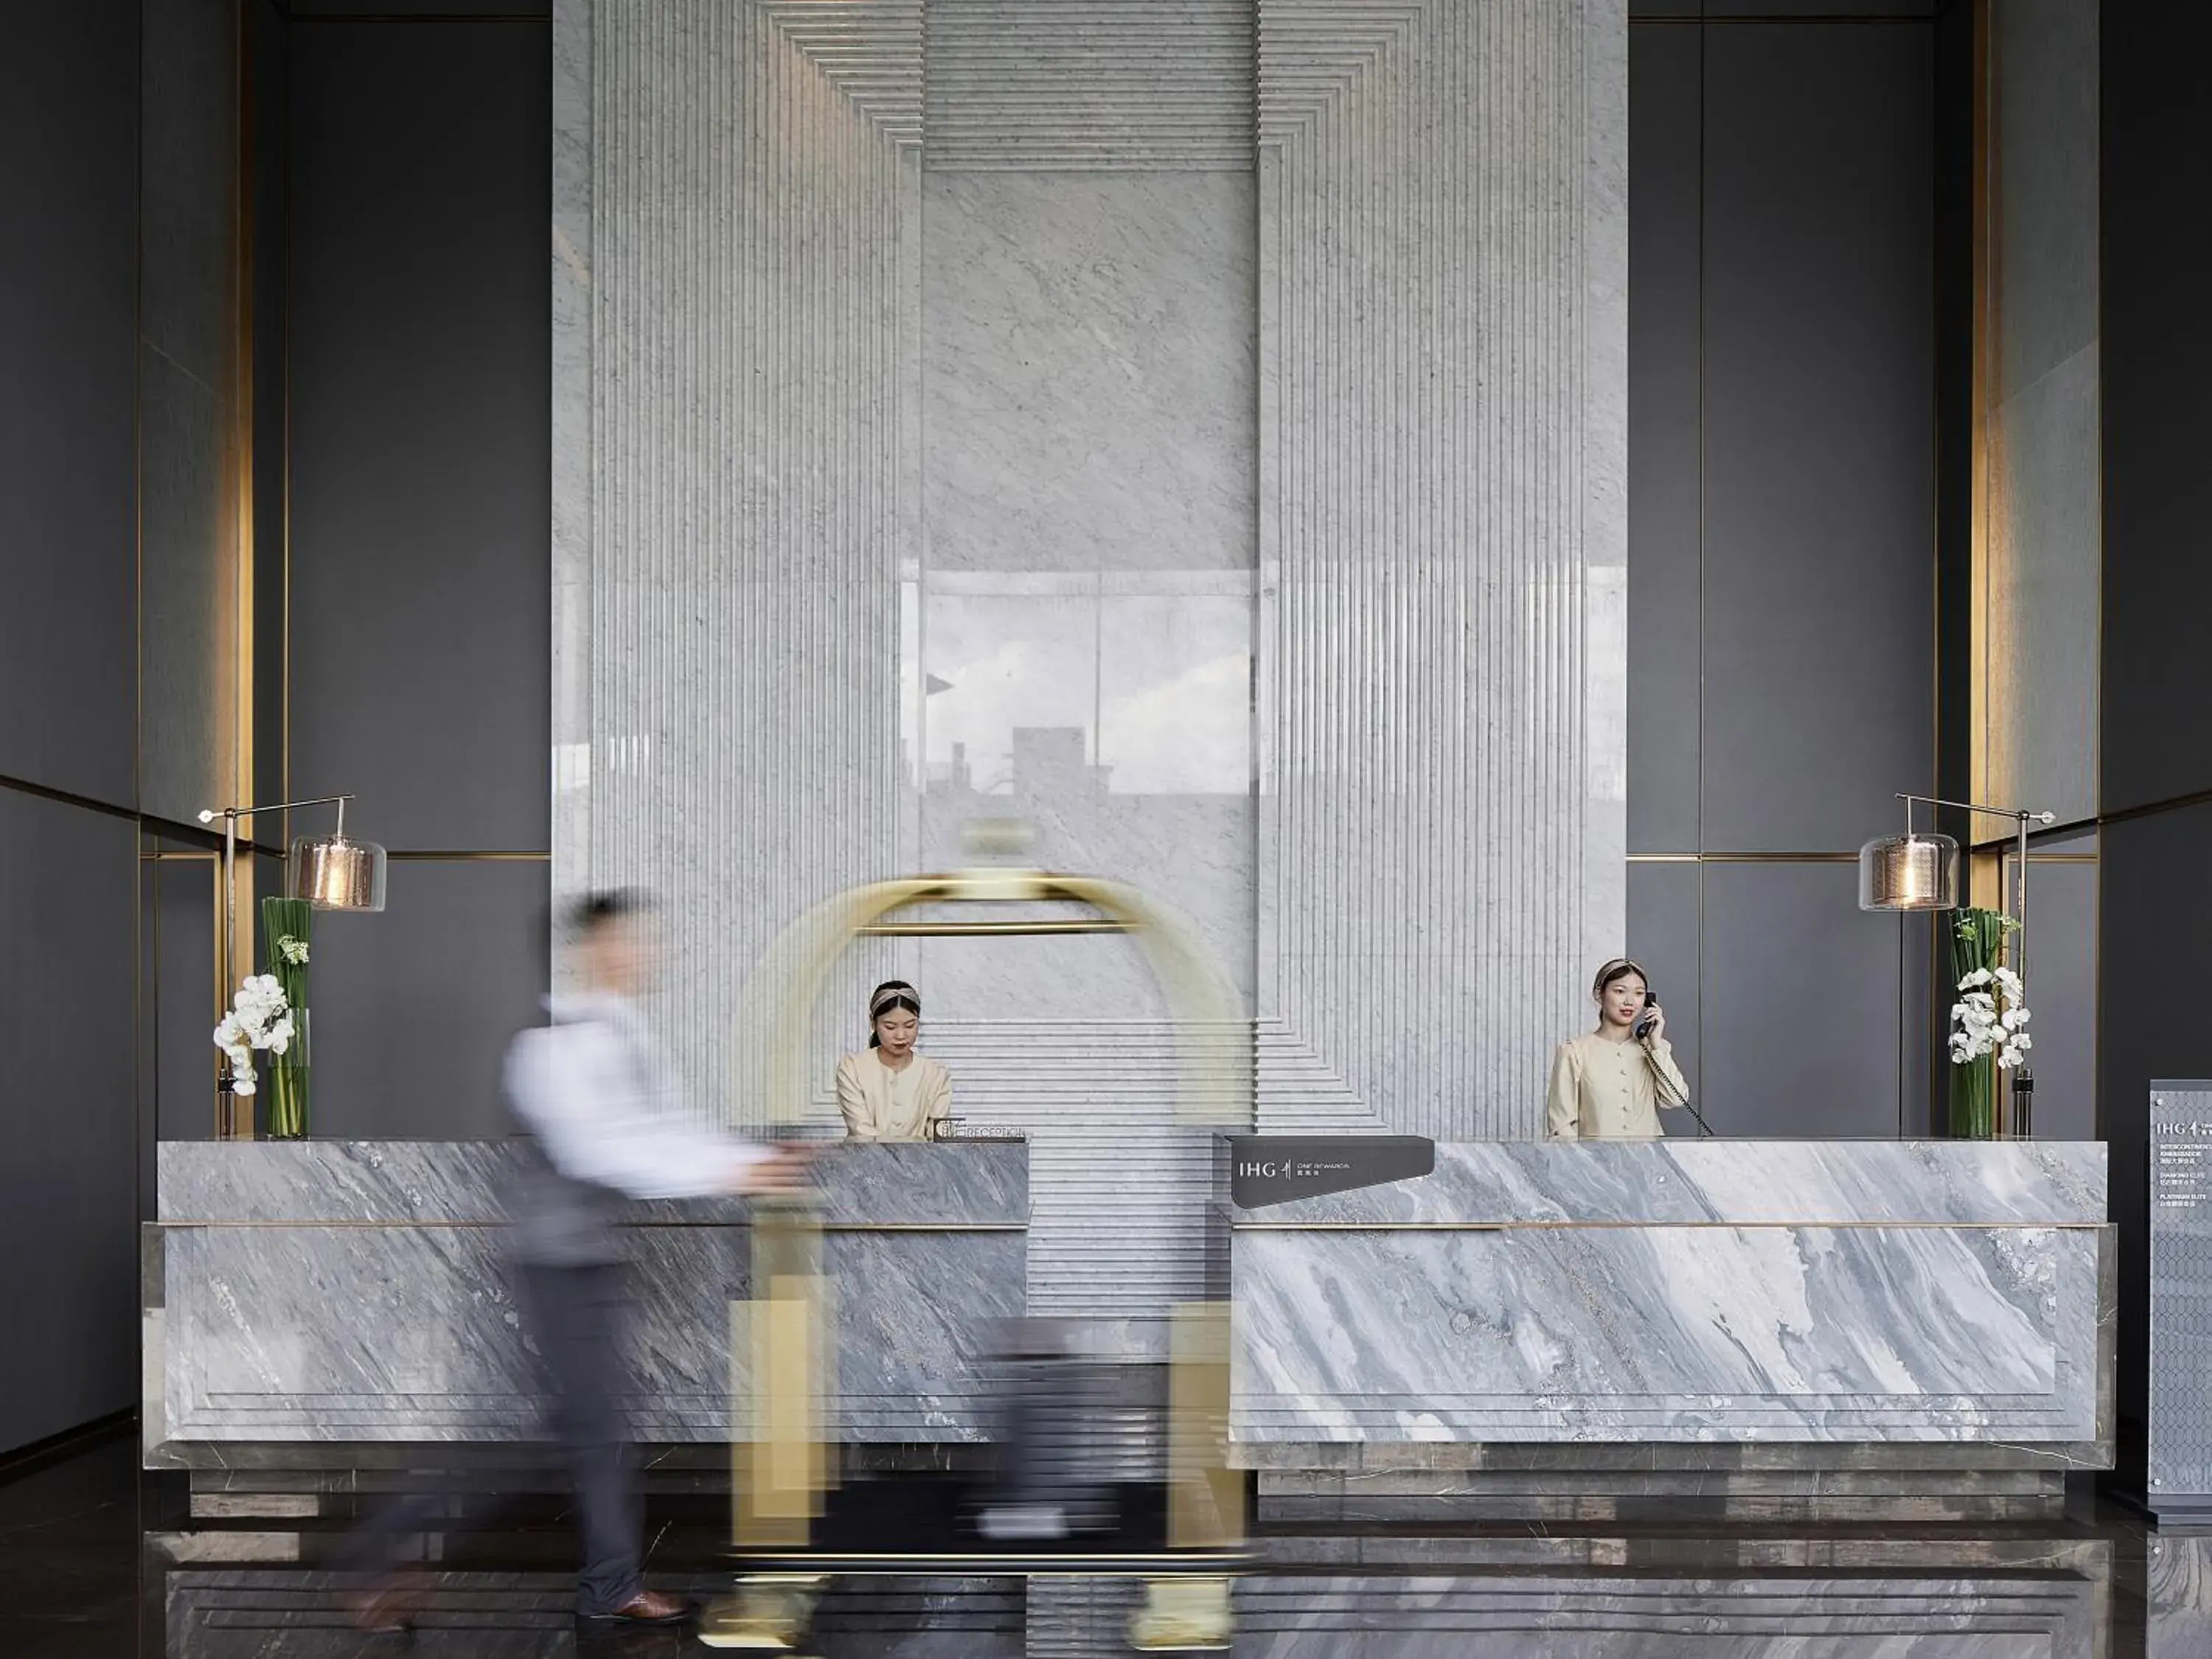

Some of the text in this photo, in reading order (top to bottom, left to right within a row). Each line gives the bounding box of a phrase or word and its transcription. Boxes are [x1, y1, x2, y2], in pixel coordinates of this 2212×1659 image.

[967, 1126, 1026, 1138] RECEPTION
[2157, 1123, 2185, 1135] IHG
[1239, 1162, 1276, 1178] IHG
